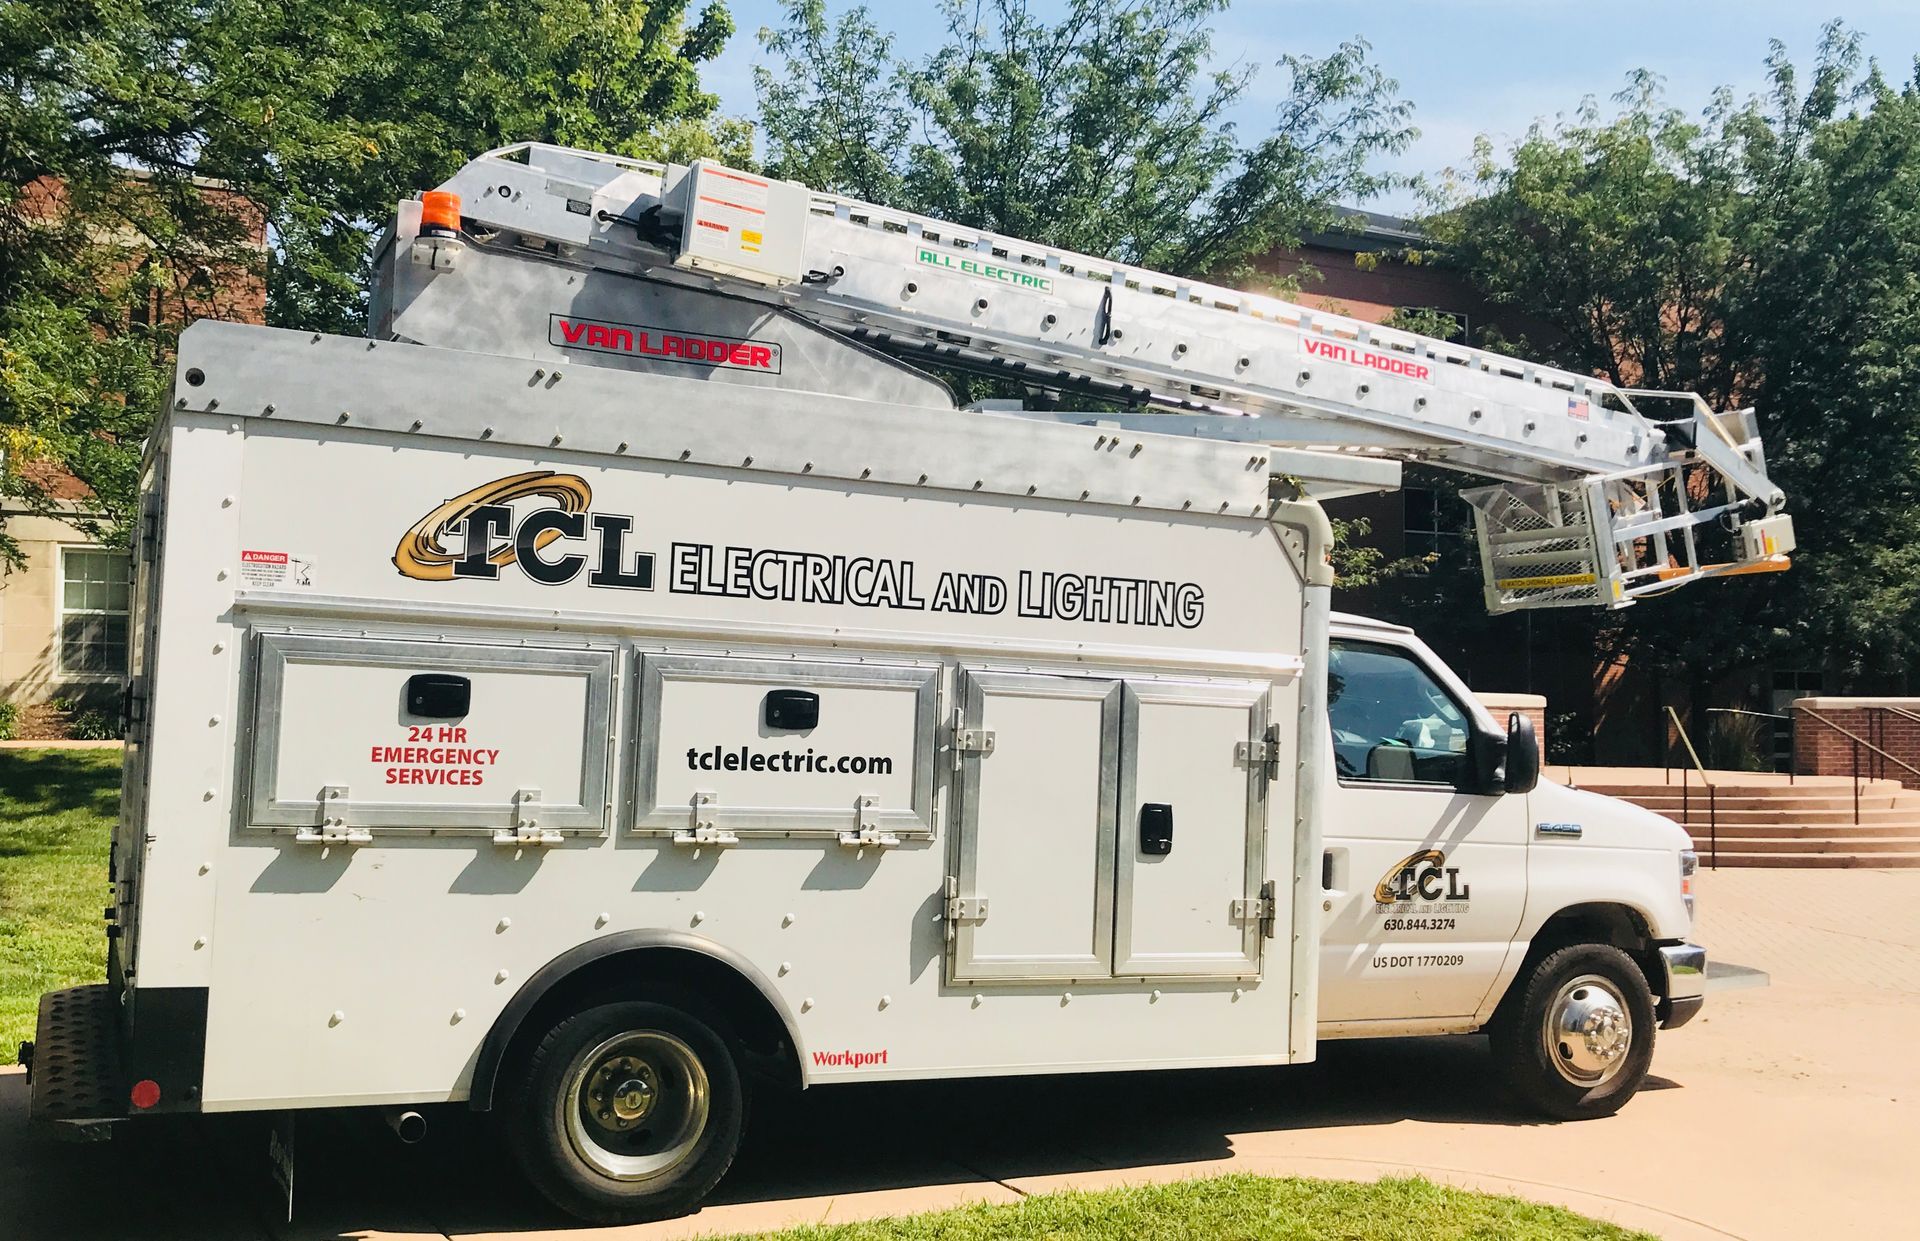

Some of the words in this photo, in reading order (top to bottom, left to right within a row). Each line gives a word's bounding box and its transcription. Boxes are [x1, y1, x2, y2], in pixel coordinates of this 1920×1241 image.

[920, 250, 956, 269] ALL
[961, 260, 1051, 291] ELECTRIC
[559, 320, 633, 351] VAN
[639, 333, 772, 368] LADDER
[1304, 338, 1346, 361] VAN
[1351, 350, 1429, 380] LADDER
[443, 499, 656, 592] TCL
[252, 554, 286, 562] DANGER
[669, 542, 925, 611] ELECTRICAL
[931, 572, 1007, 615] AND
[1017, 570, 1204, 629] LIGHTING
[408, 727, 433, 742] 24
[438, 727, 467, 743] HR
[371, 747, 500, 765] EMERGENCY
[687, 745, 893, 775] tclelectric.com
[386, 768, 484, 786] SERVICES
[1392, 866, 1471, 902] TCL
[1434, 902, 1470, 914] LIGHTING
[1384, 918, 1456, 931] 630.844.3274
[1373, 956, 1388, 968] US
[1390, 956, 1414, 967] DOT
[1417, 954, 1464, 967] 1770209
[812, 1049, 888, 1069] Workport
